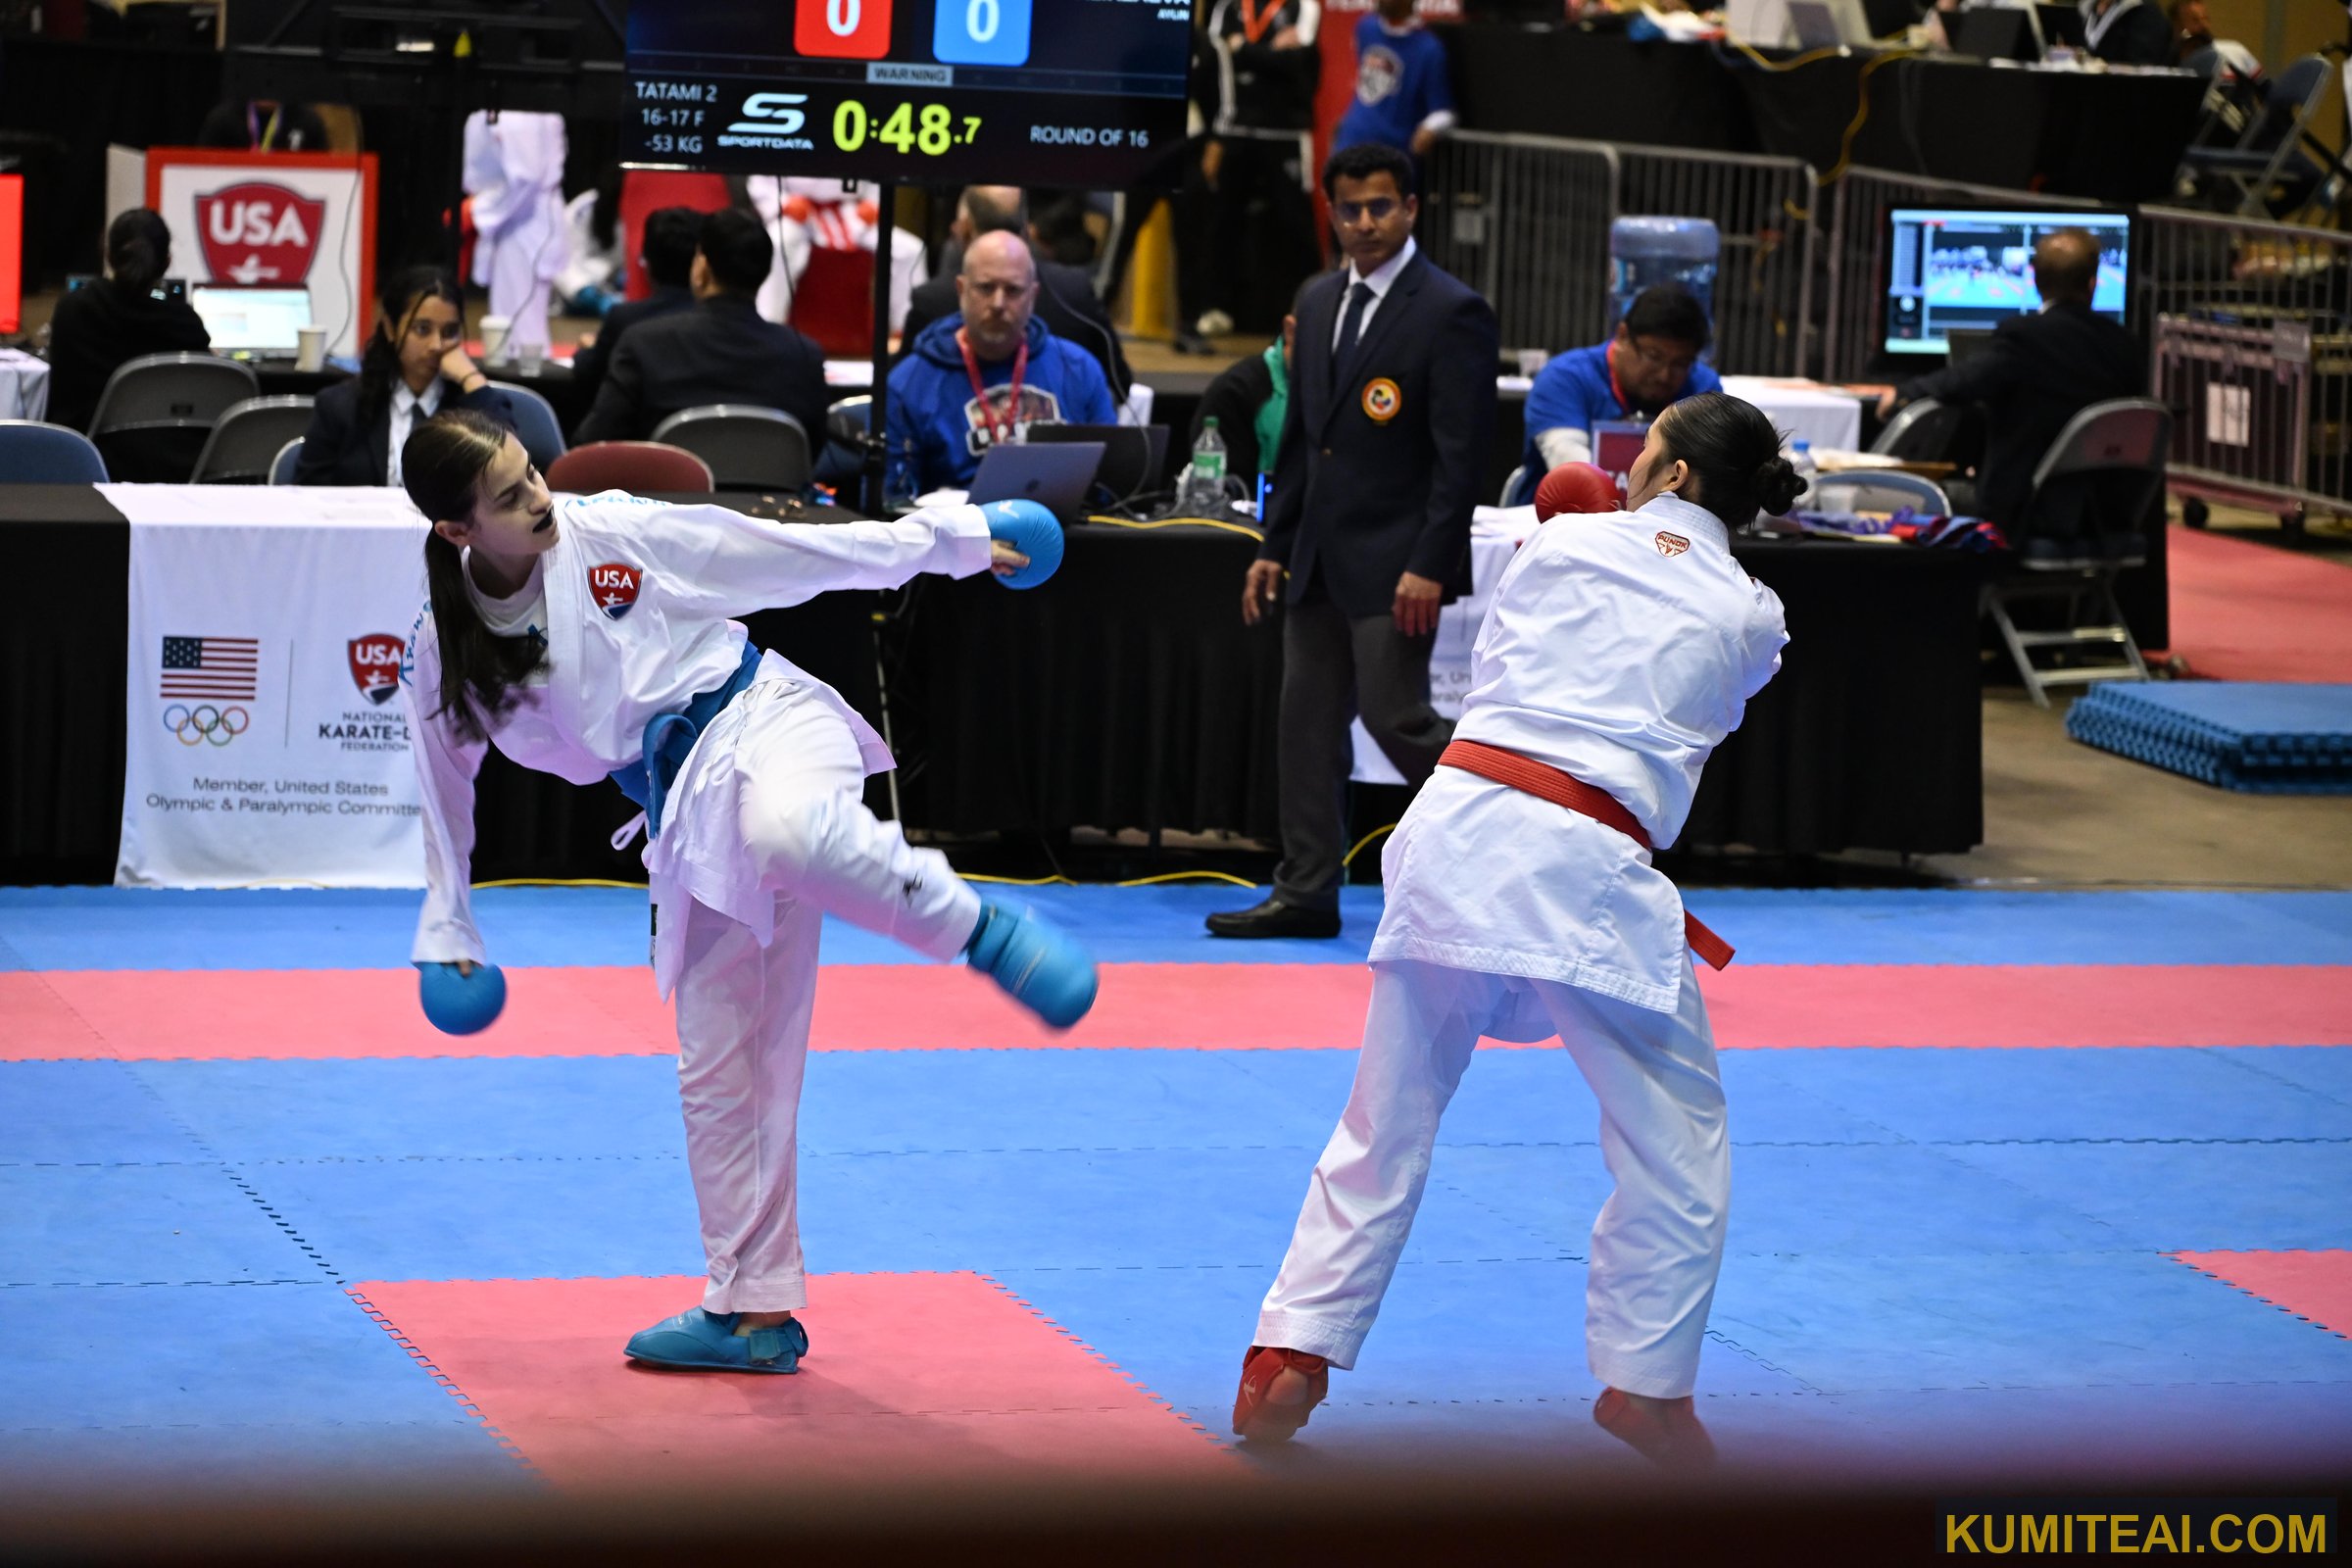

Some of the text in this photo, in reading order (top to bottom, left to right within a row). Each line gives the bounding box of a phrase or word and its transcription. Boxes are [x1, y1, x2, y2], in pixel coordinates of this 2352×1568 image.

[826, 0, 861, 36] 0
[966, 0, 1000, 43] 0
[874, 68, 947, 81] WARNING
[635, 81, 718, 103] TATAMI 2
[642, 108, 706, 127] 16-17 F
[645, 134, 703, 154] -53 KG
[716, 134, 814, 150] SPORTDATA
[1030, 125, 1150, 148] ROUND OF 16
[211, 201, 309, 247] USA
[595, 569, 634, 589] USA
[355, 643, 401, 665] USA
[318, 723, 411, 740] KARATE-D
[341, 742, 409, 752] FEDERATION
[193, 777, 388, 797] Member, United States
[146, 794, 420, 816] Olympic & Paralympic Committe
